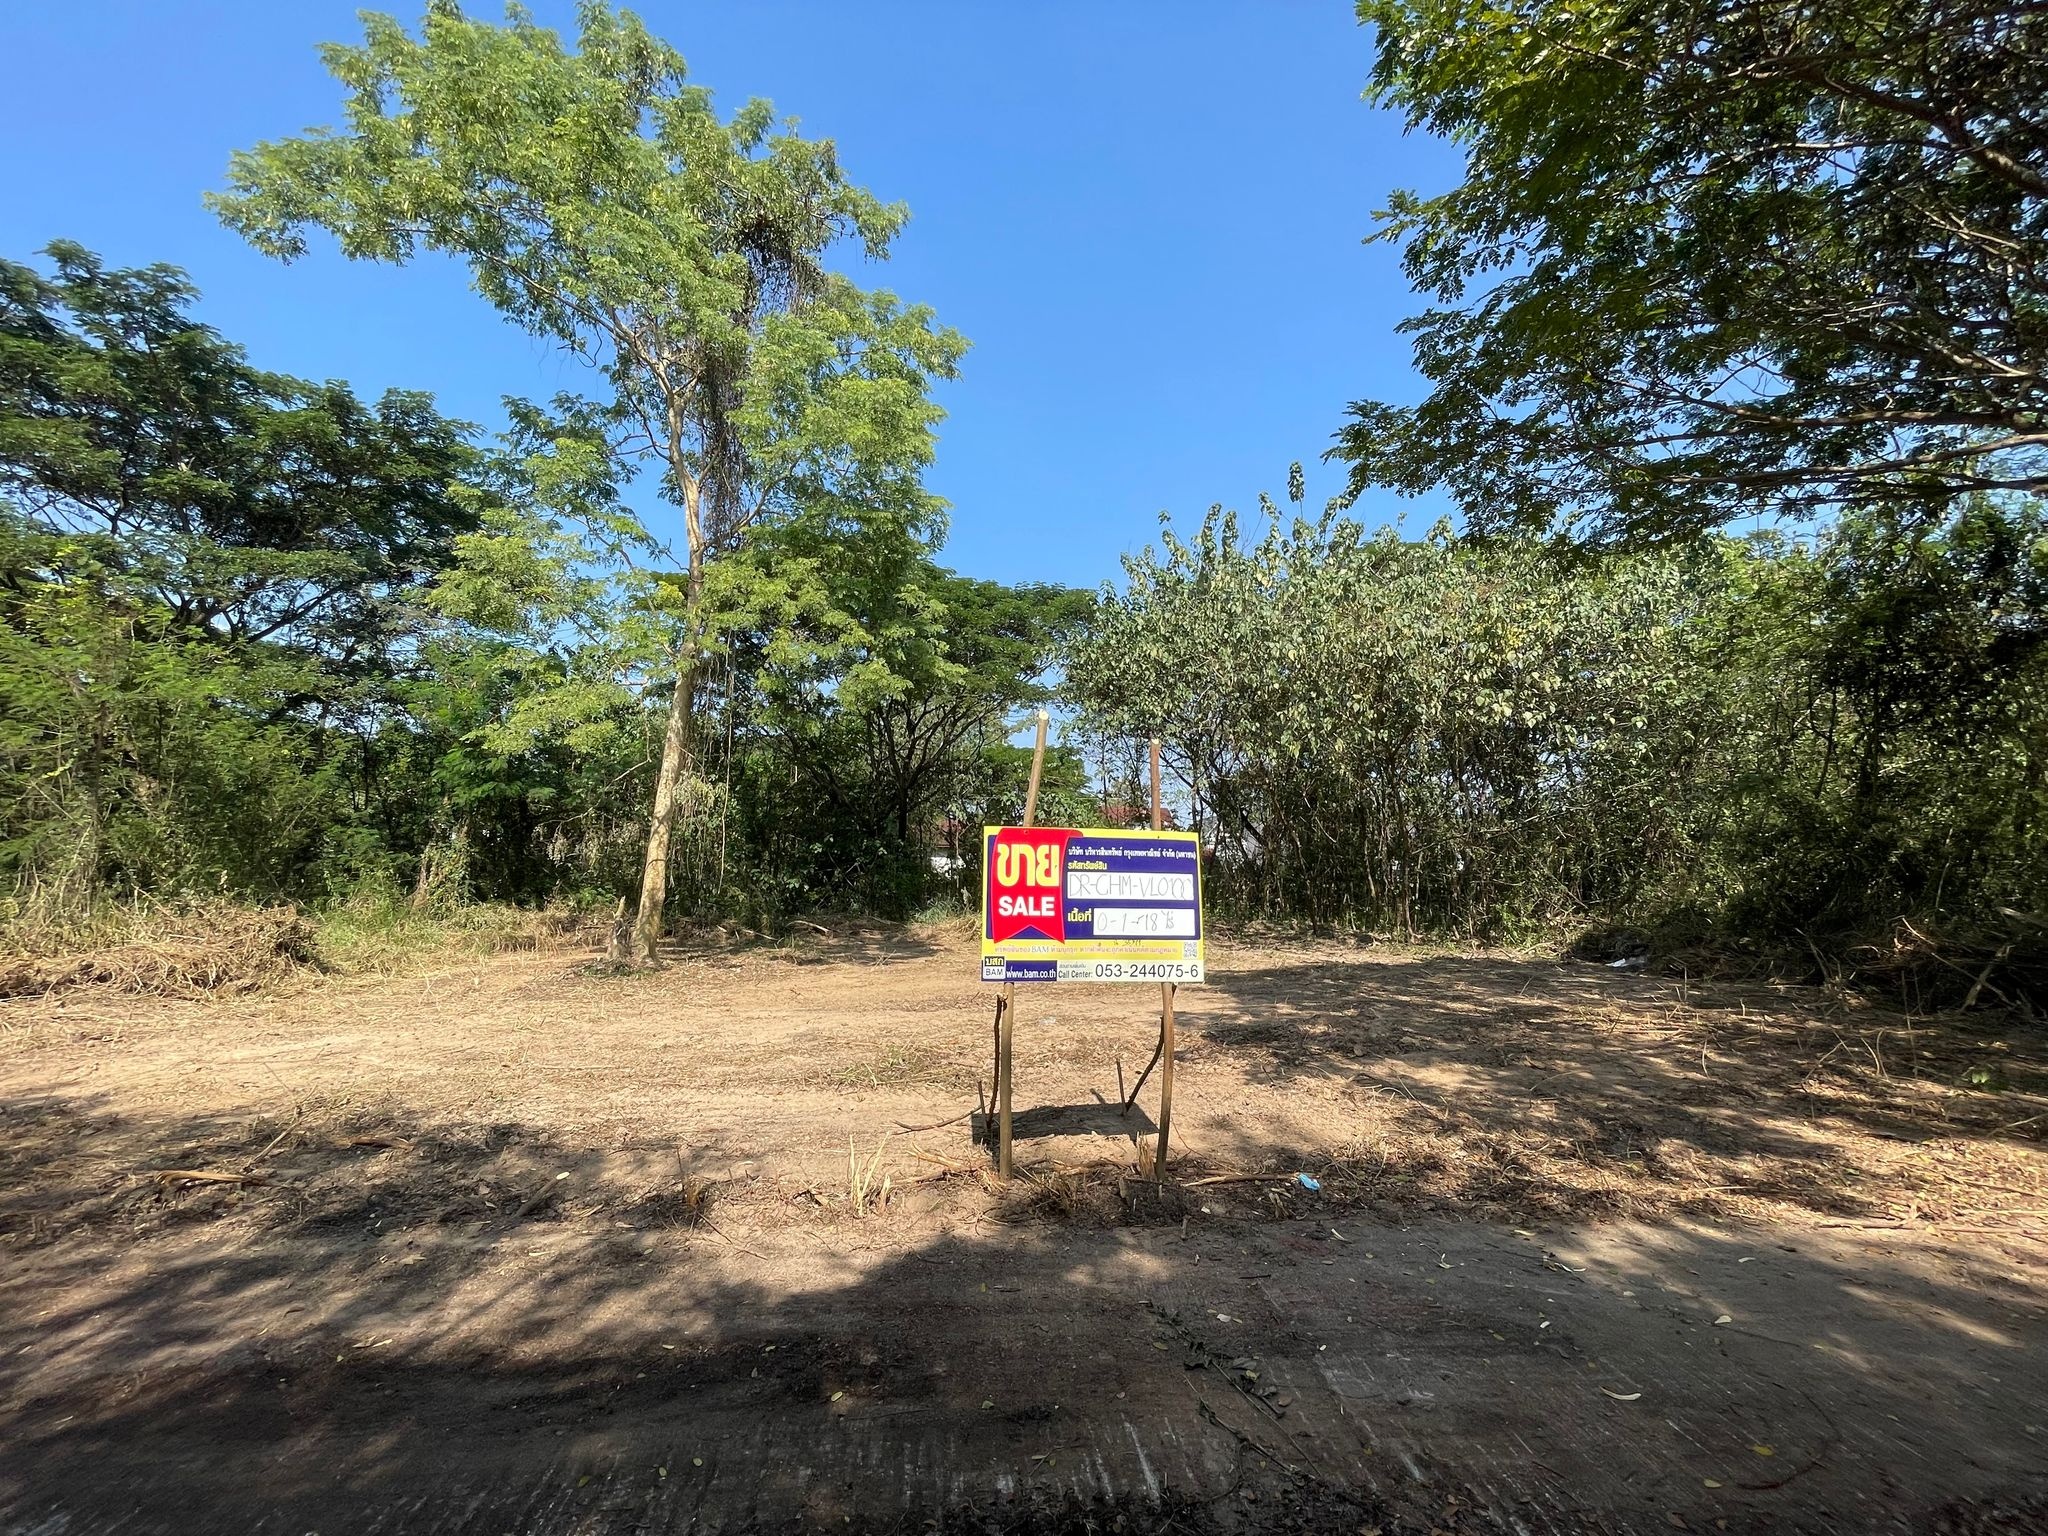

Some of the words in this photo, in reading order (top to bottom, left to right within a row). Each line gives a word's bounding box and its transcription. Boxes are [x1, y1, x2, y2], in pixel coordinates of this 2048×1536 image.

[997, 843, 1060, 887] ขาย
[998, 895, 1056, 917] SALE
[1067, 907, 1092, 922] เนื้อที่
[1031, 945, 1049, 953] BAM
[985, 968, 1003, 976] BAM
[1006, 968, 1056, 978] www.bam.co.th
[1058, 970, 1070, 978] Call
[1071, 970, 1093, 978] Center:
[1095, 964, 1199, 978] 053-244075-6
